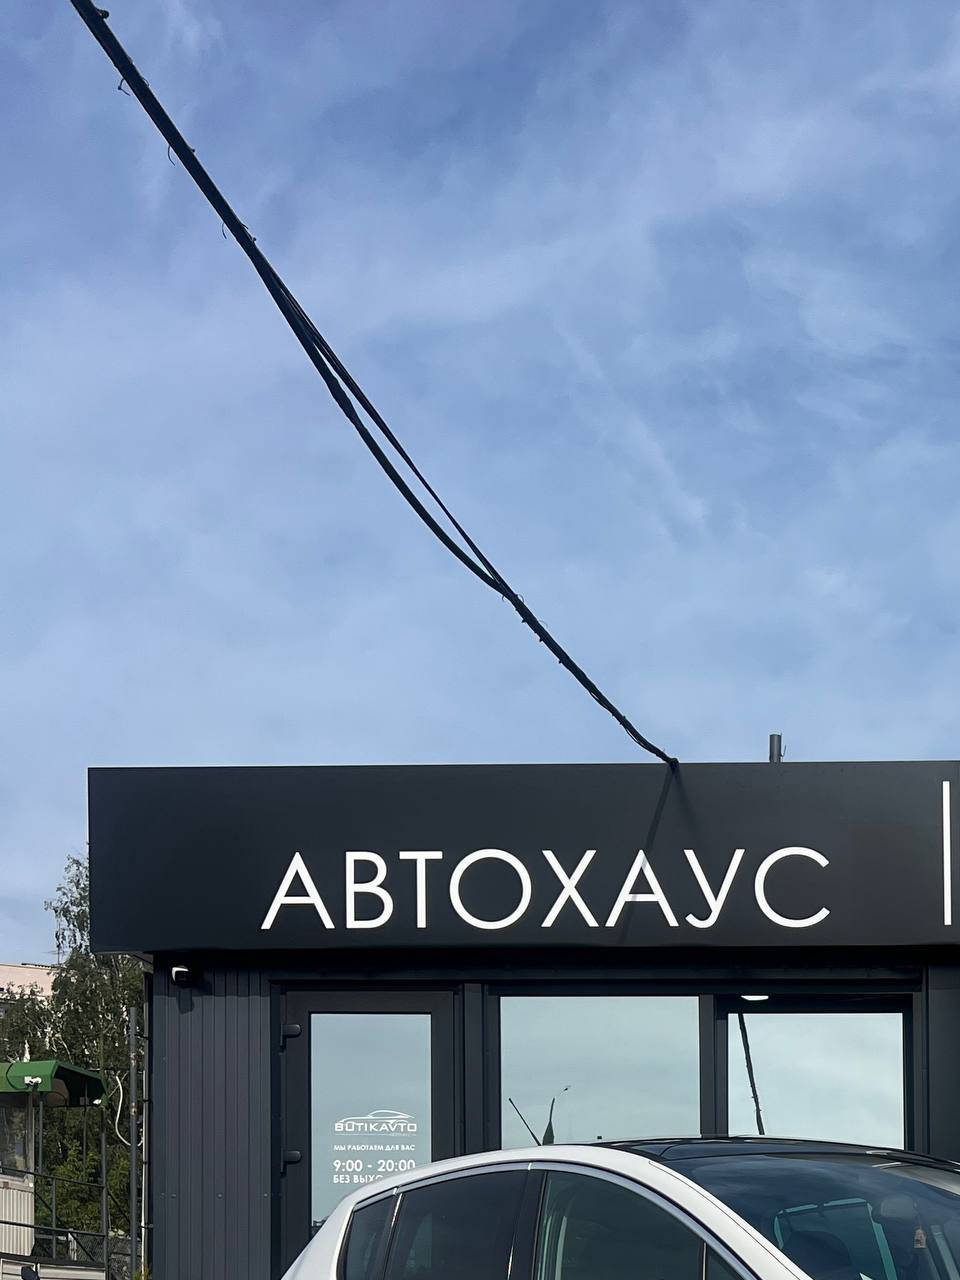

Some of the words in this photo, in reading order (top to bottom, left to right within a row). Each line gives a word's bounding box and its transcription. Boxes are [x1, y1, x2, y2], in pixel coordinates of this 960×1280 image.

[261, 846, 831, 930] АВТОХАУС
[334, 1121, 417, 1132] BUTIKAVTO
[333, 1159, 363, 1172] 9:00
[377, 1159, 416, 1172] 20:00
[333, 1174, 350, 1184] БЕЗ
